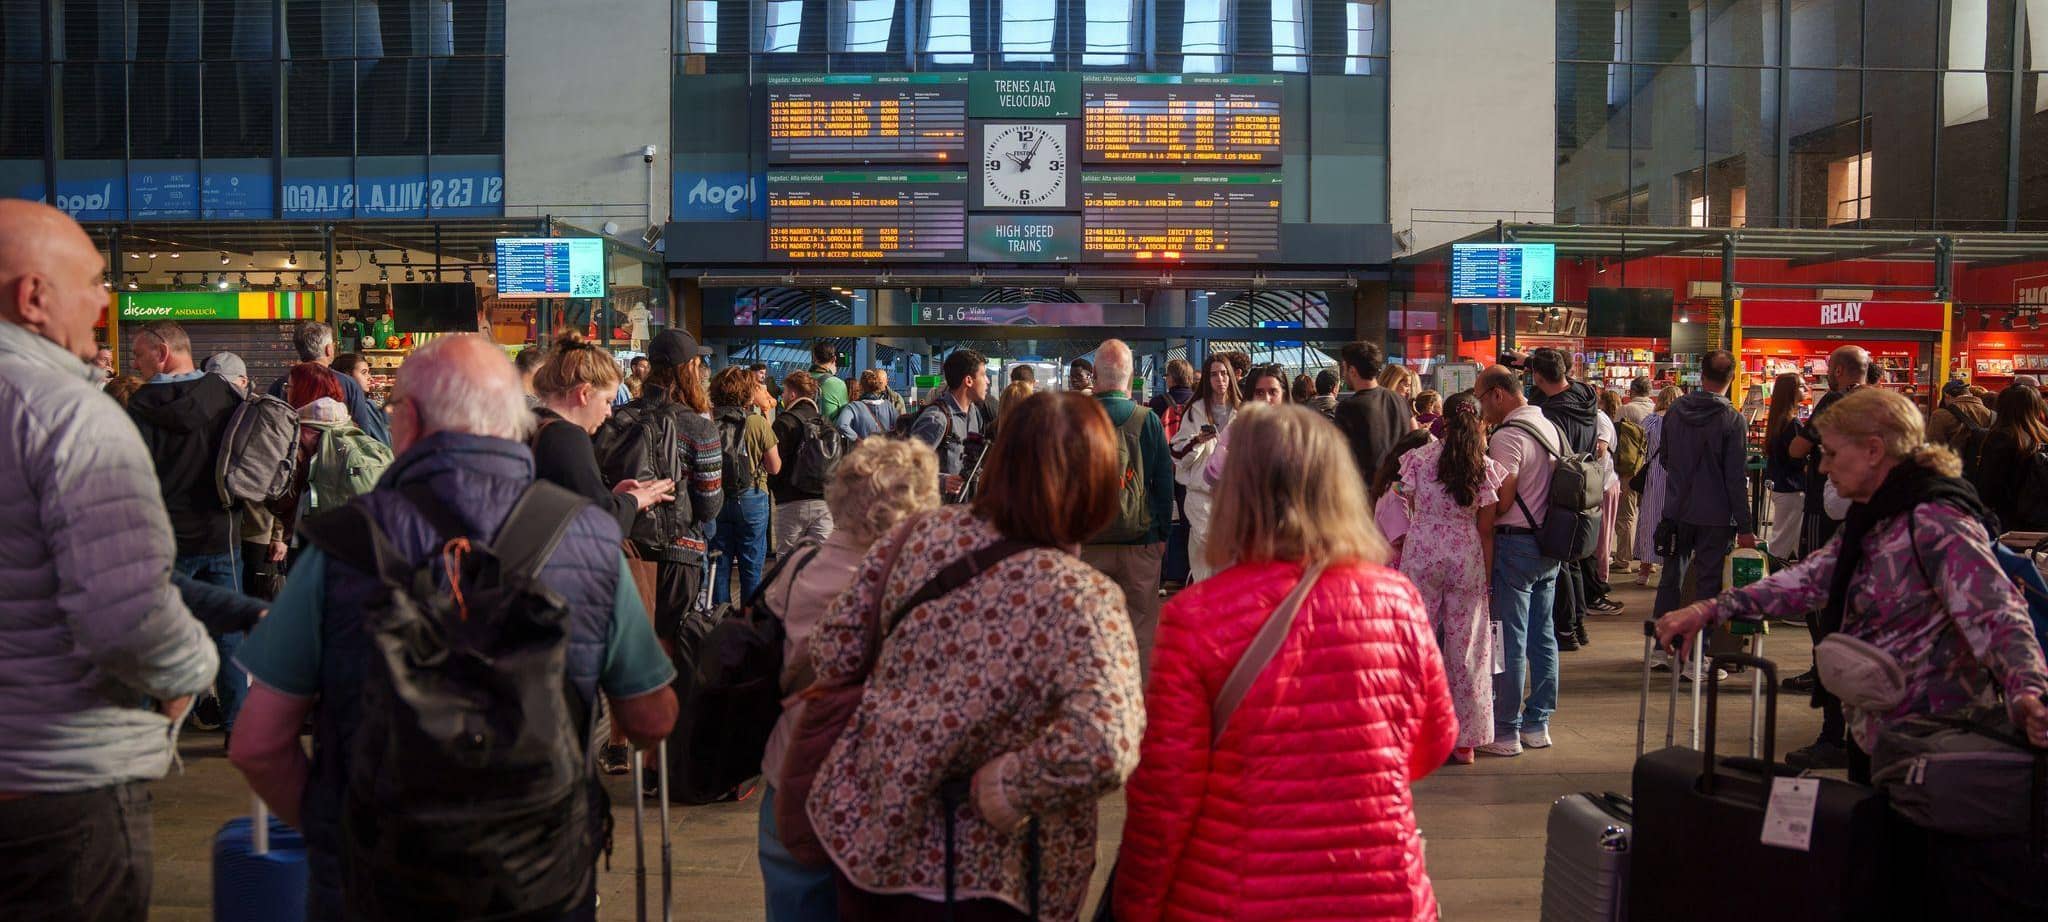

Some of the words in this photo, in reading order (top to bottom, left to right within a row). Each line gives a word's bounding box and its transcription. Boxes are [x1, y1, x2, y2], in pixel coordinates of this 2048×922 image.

[995, 80, 1030, 92] TRENES
[1033, 80, 1056, 93] ALTA
[1000, 95, 1051, 107] VELOCIDAD
[1018, 132, 1033, 141] 12
[991, 160, 1001, 170] 9
[1049, 160, 1060, 170] 3
[1020, 190, 1029, 200] 6
[996, 225, 1021, 238] HIGH
[1024, 225, 1054, 238] SPEED
[1008, 240, 1042, 252] TRAINS
[123, 296, 173, 316] discover
[936, 307, 945, 321] 1
[956, 306, 966, 321] 6
[1820, 303, 1862, 325] RELAY
